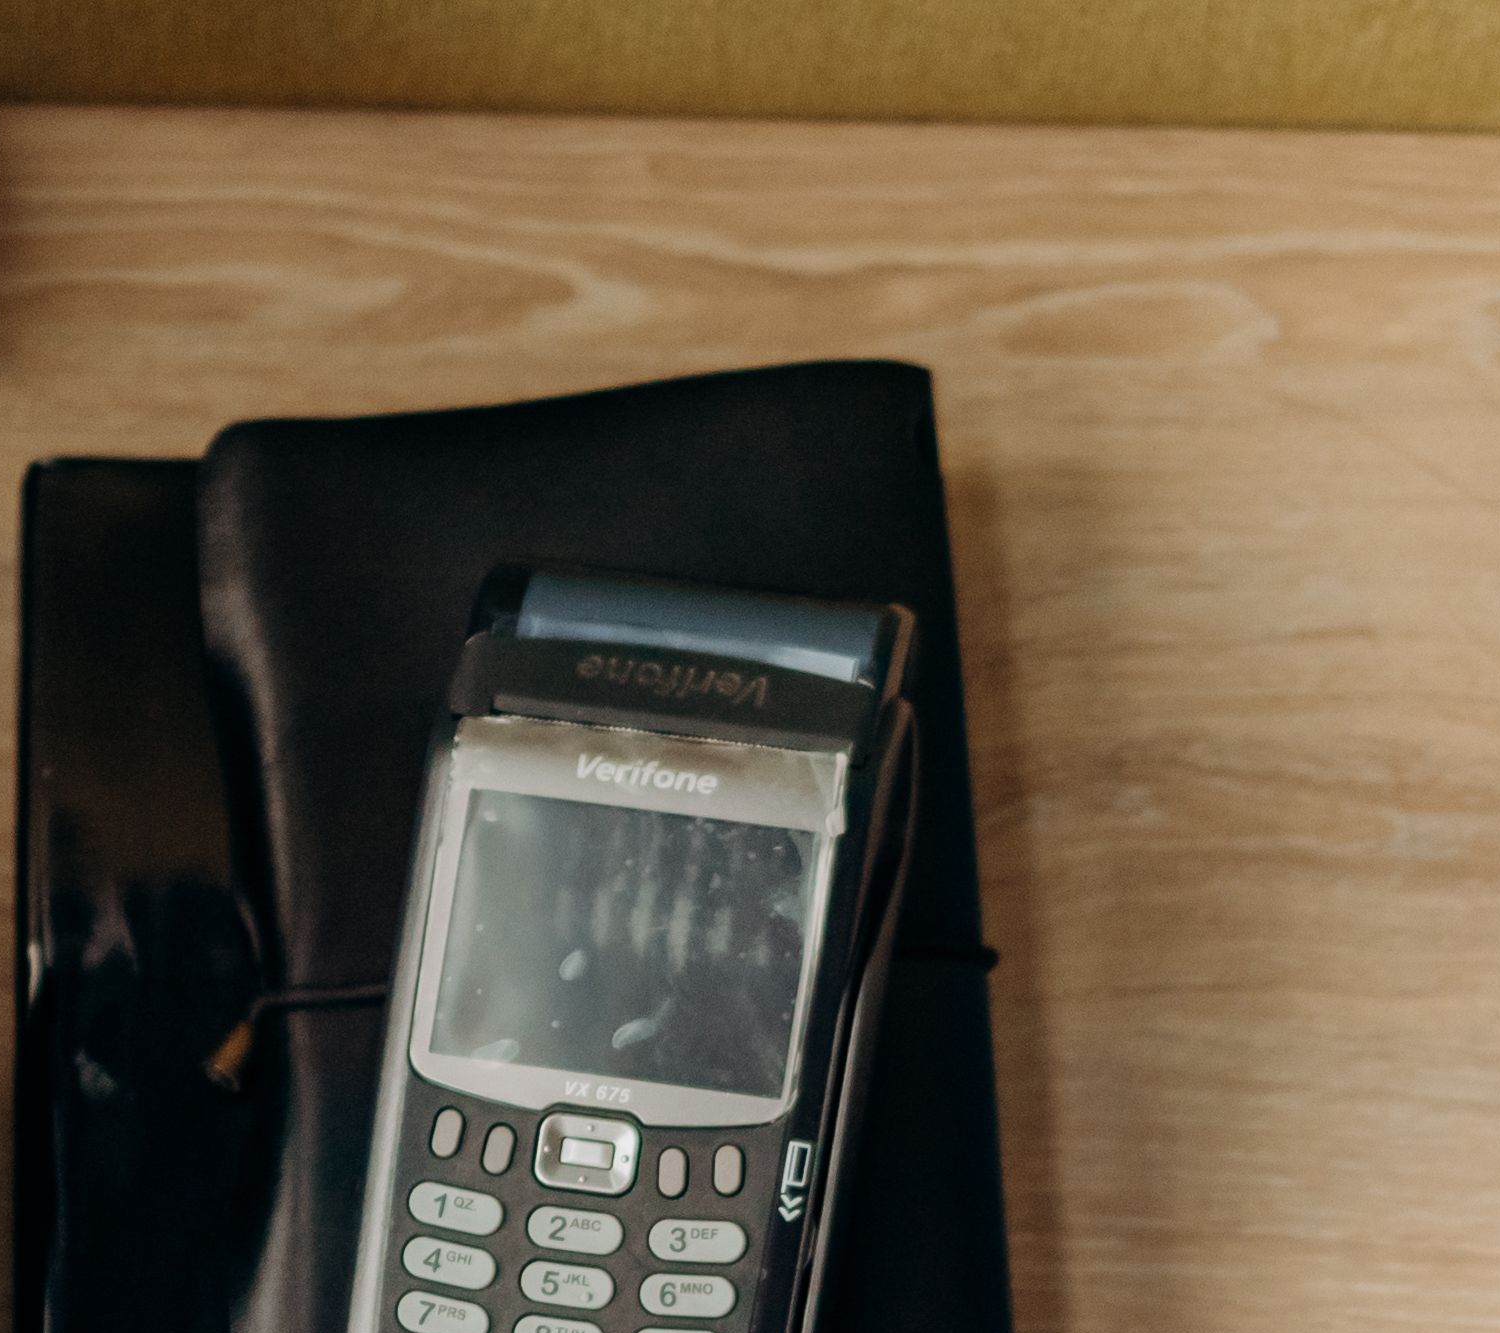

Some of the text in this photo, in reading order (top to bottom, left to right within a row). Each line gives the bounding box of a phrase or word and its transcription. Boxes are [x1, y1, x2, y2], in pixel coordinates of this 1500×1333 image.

[575, 653, 770, 707] Verifone
[574, 752, 719, 796] Verifone
[562, 1078, 632, 1104] VX 675
[433, 1192, 475, 1219] 1 QZ
[547, 1215, 602, 1242] 2 ABC
[668, 1227, 720, 1253] 3 DEF
[422, 1247, 473, 1273] 4 GHI
[540, 1270, 590, 1296] 5 JKL
[658, 1281, 715, 1308] 6 MNO
[418, 1299, 467, 1326] 7 PRS
